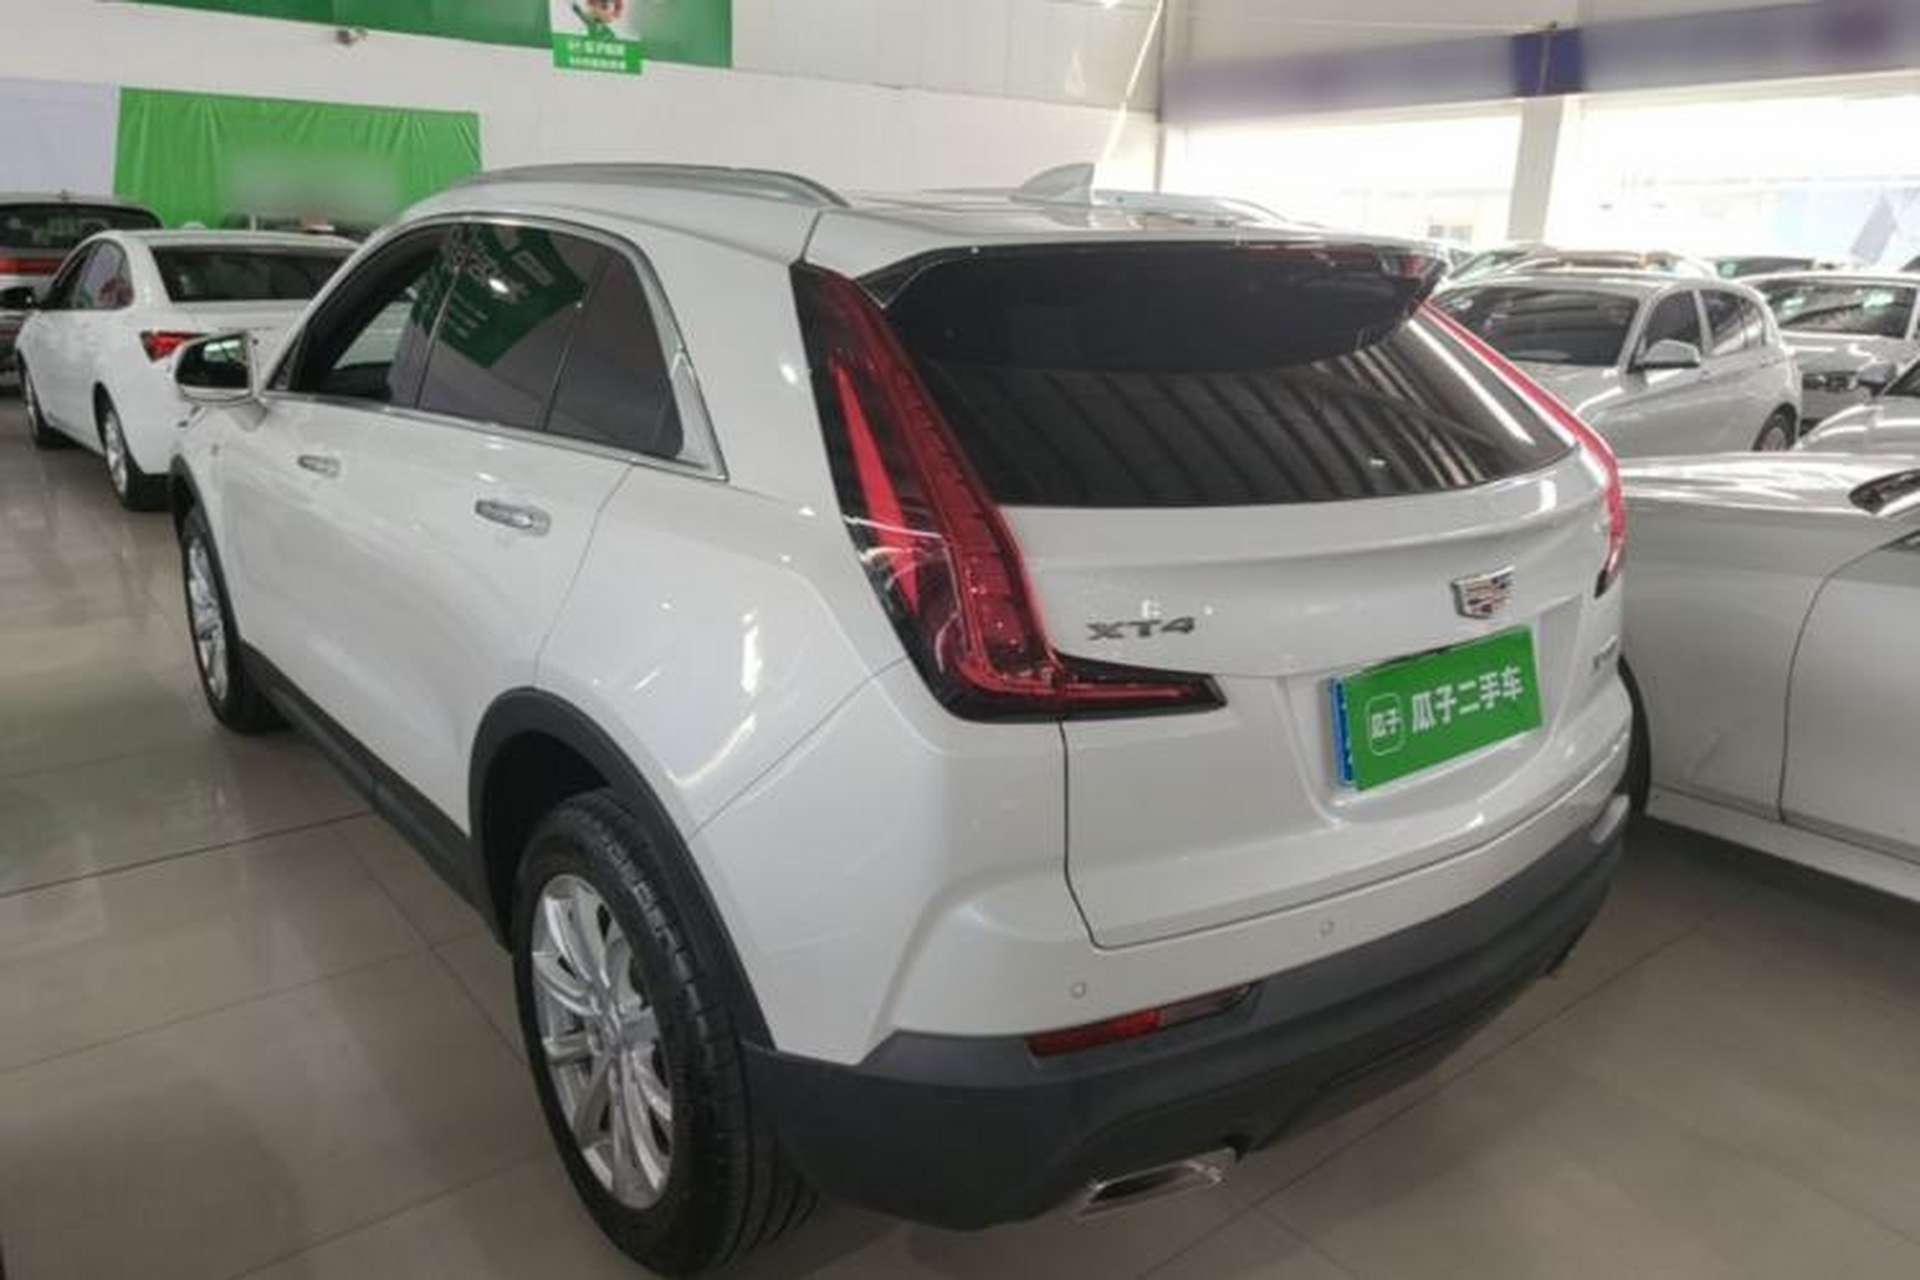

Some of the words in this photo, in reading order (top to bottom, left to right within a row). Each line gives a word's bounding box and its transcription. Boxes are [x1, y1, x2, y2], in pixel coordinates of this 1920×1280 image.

[1087, 616, 1195, 640] XT4
[1411, 664, 1524, 734] 瓜子二手车
[1370, 707, 1400, 739] 瓜子
